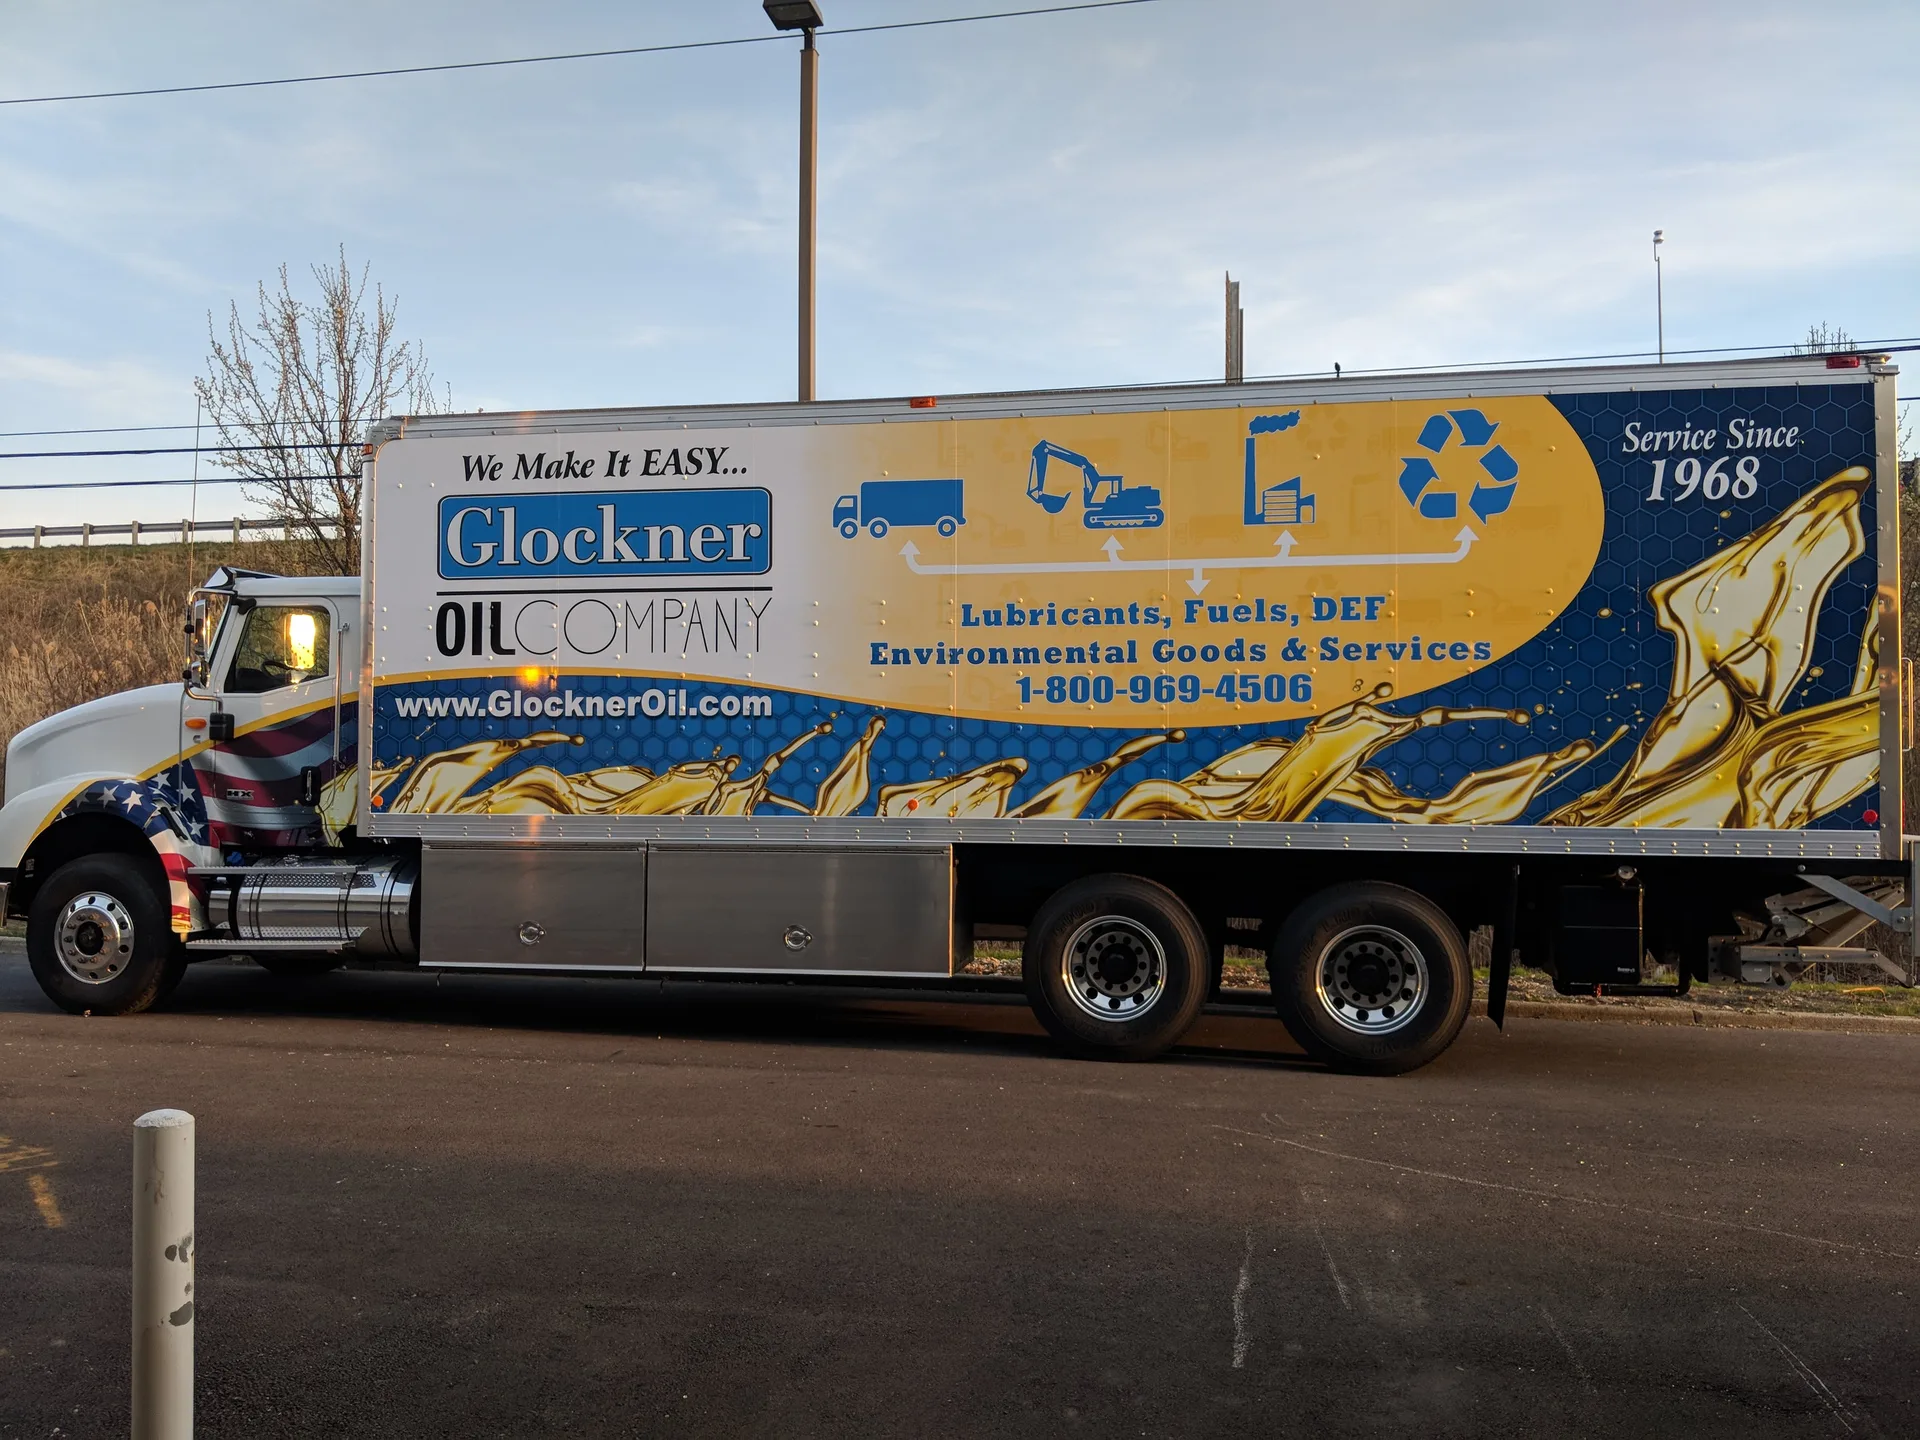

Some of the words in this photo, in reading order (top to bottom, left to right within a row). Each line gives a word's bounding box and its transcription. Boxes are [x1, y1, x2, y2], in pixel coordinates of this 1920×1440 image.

[1621, 421, 1717, 453] Service
[1725, 417, 1799, 449] Since
[462, 454, 502, 482] We
[512, 450, 595, 481] Make
[604, 449, 631, 477] It
[640, 446, 748, 476] EASY...
[1645, 455, 1761, 502] 1968
[446, 503, 762, 567] Glockner
[961, 601, 1173, 629] Lubricants,
[1184, 598, 1300, 627] Fuels,
[1312, 596, 1387, 621] DEF
[869, 640, 1138, 666] Environmental
[1151, 637, 1268, 662] Goods
[1280, 637, 1308, 662] &
[1319, 636, 1493, 662] Services
[395, 688, 773, 719] www.GlocknerOil.com
[1015, 673, 1314, 704] 1-800-969-4506
[226, 788, 253, 801] HX
